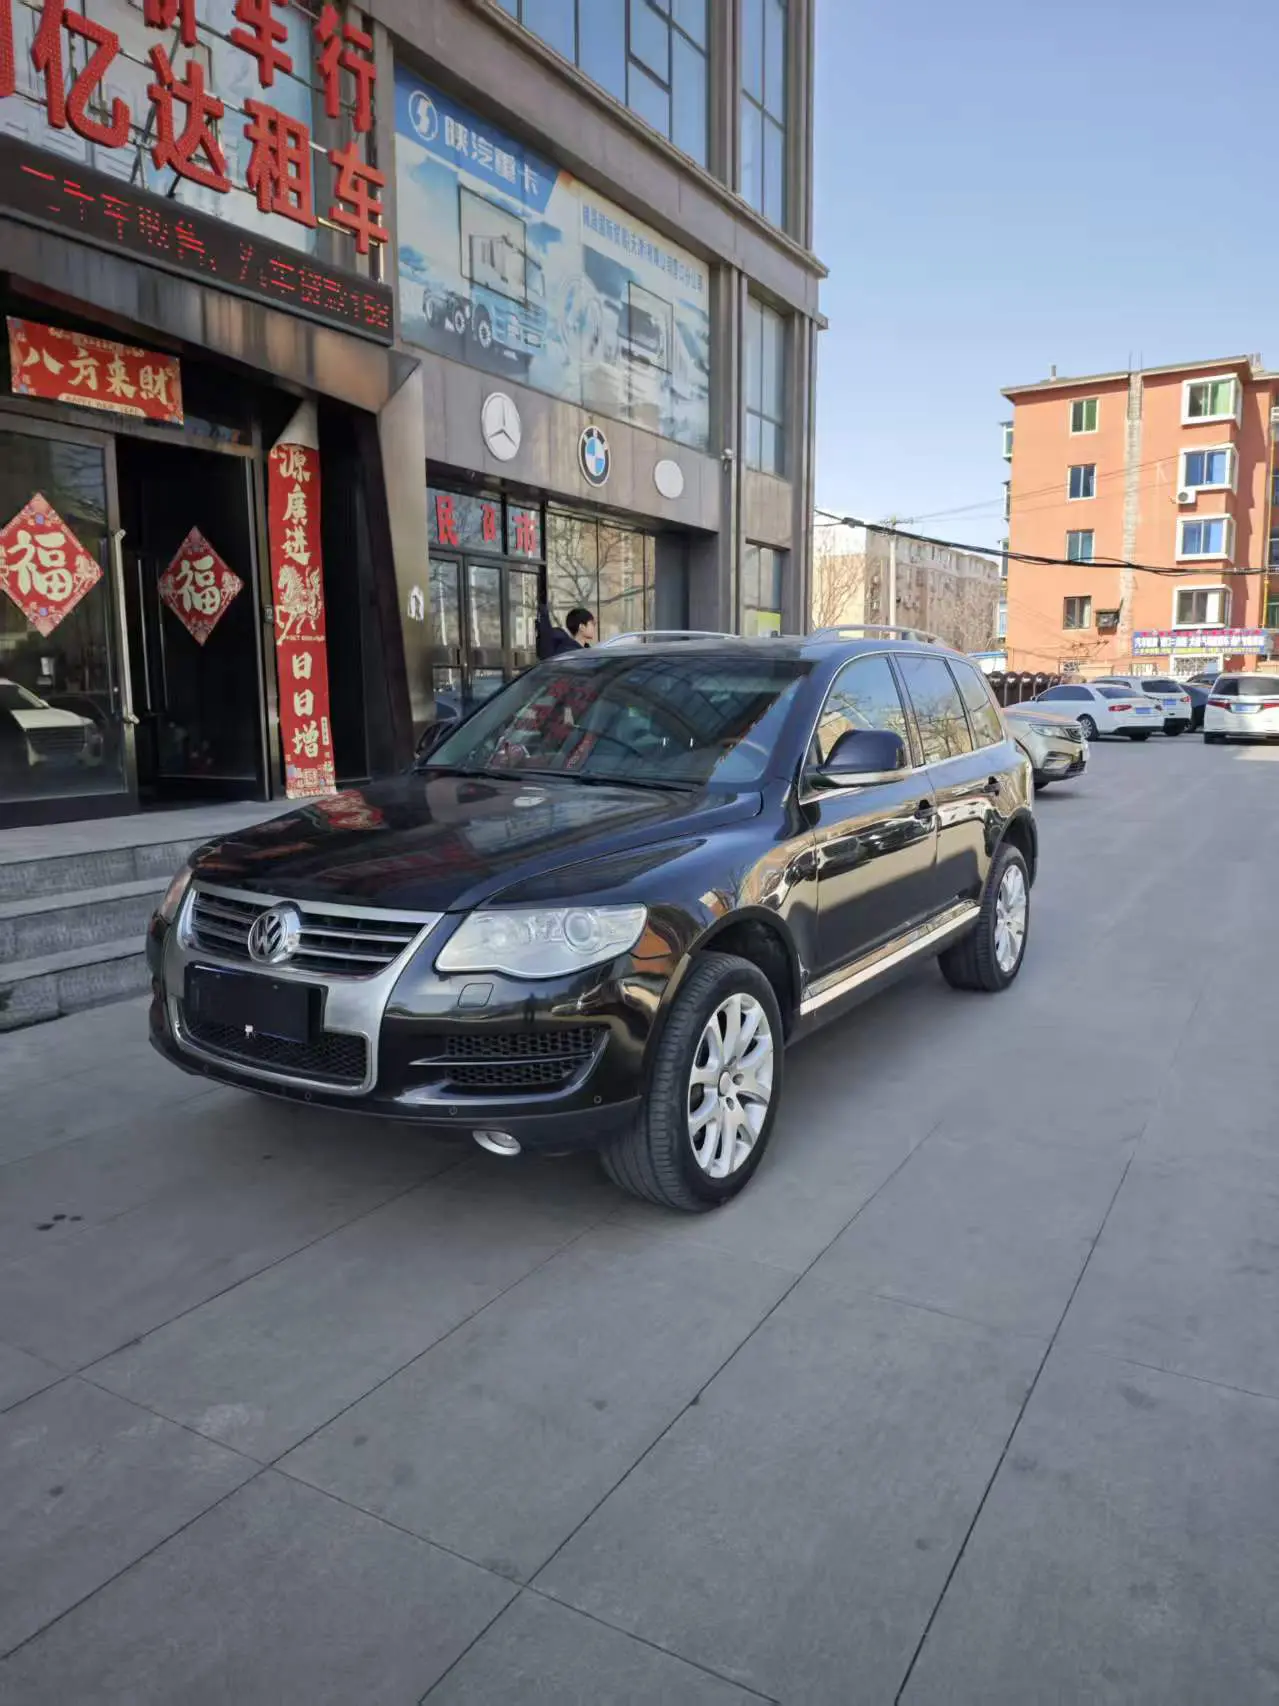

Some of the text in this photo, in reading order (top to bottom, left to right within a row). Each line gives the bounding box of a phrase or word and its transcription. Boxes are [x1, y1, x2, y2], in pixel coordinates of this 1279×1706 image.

[0, 0, 389, 255] 亿达租车
[7, 530, 74, 602] 福
[175, 555, 222, 616] 福
[291, 651, 320, 759] 日日增
